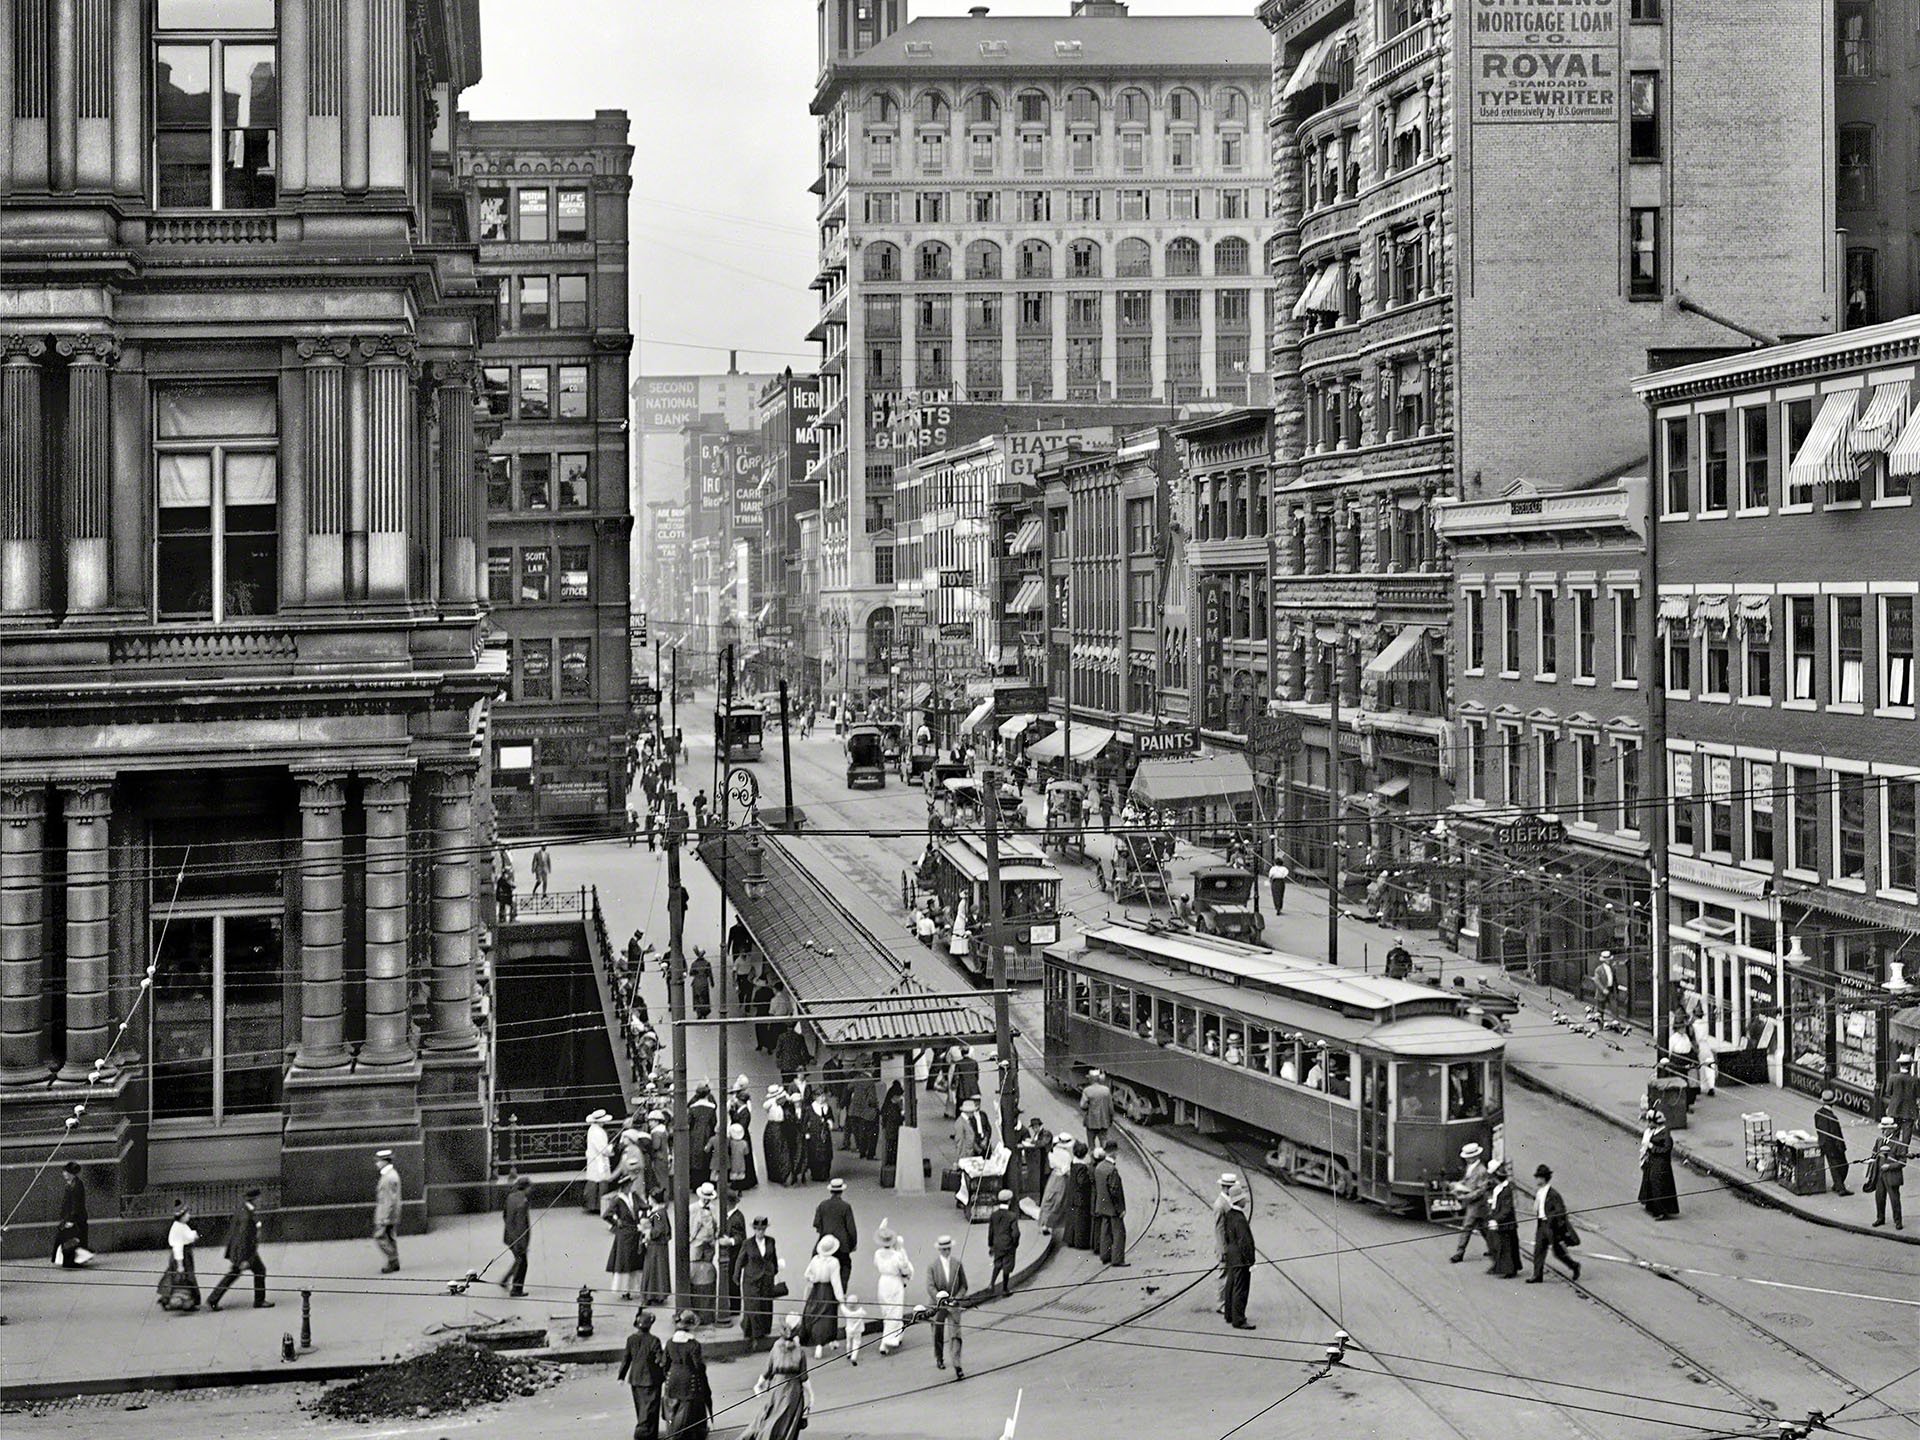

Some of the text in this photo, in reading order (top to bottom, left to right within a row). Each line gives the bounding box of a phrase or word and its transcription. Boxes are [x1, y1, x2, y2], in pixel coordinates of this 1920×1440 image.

[1477, 12, 1613, 32] MORTGAGE LOAN
[1483, 53, 1612, 78] ROYAL
[1508, 79, 1588, 88] STANDARD
[1478, 90, 1614, 105] TYPEWRITER
[1480, 107, 1499, 117] Used
[1501, 107, 1544, 119] extensively
[1547, 107, 1555, 118] by
[561, 194, 583, 202] LIFE
[649, 381, 694, 393] SECOND
[646, 396, 698, 409] NATIONAL
[872, 389, 948, 407] WILSON
[655, 413, 690, 425] BANK
[872, 407, 950, 428] PAINTS
[875, 427, 947, 449] GLASS
[1010, 435, 1082, 454] HATS
[1205, 589, 1219, 718] ADMIRAL
[1141, 733, 1193, 751] PAINTS
[1499, 826, 1559, 844] SIEFKE
[1791, 1072, 1822, 1094] DRUGS
[1834, 1089, 1871, 1112] DOW'S
